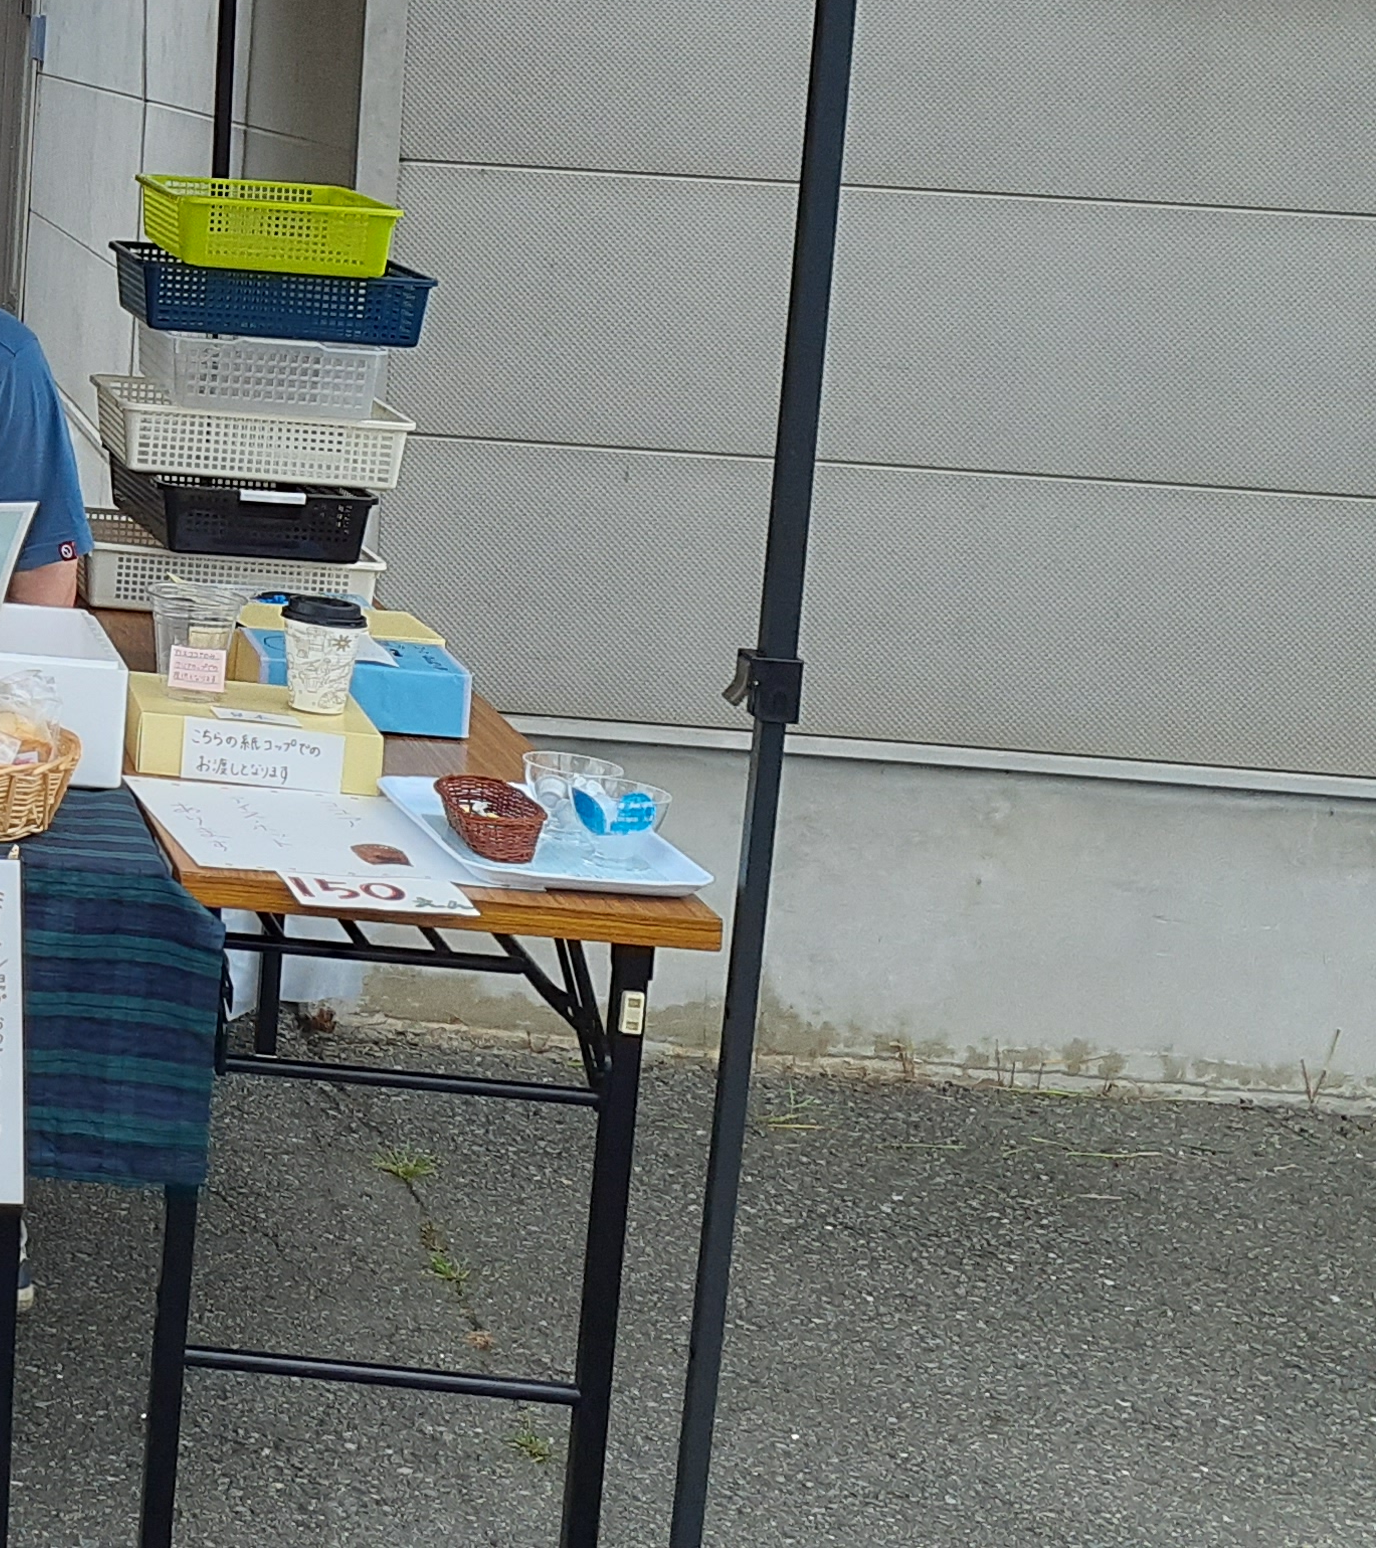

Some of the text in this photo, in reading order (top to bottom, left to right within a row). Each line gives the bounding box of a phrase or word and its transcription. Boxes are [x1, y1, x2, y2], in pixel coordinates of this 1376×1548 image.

[191, 729, 321, 757] こちらの紙コップでの
[196, 755, 290, 785] お渡しとなります
